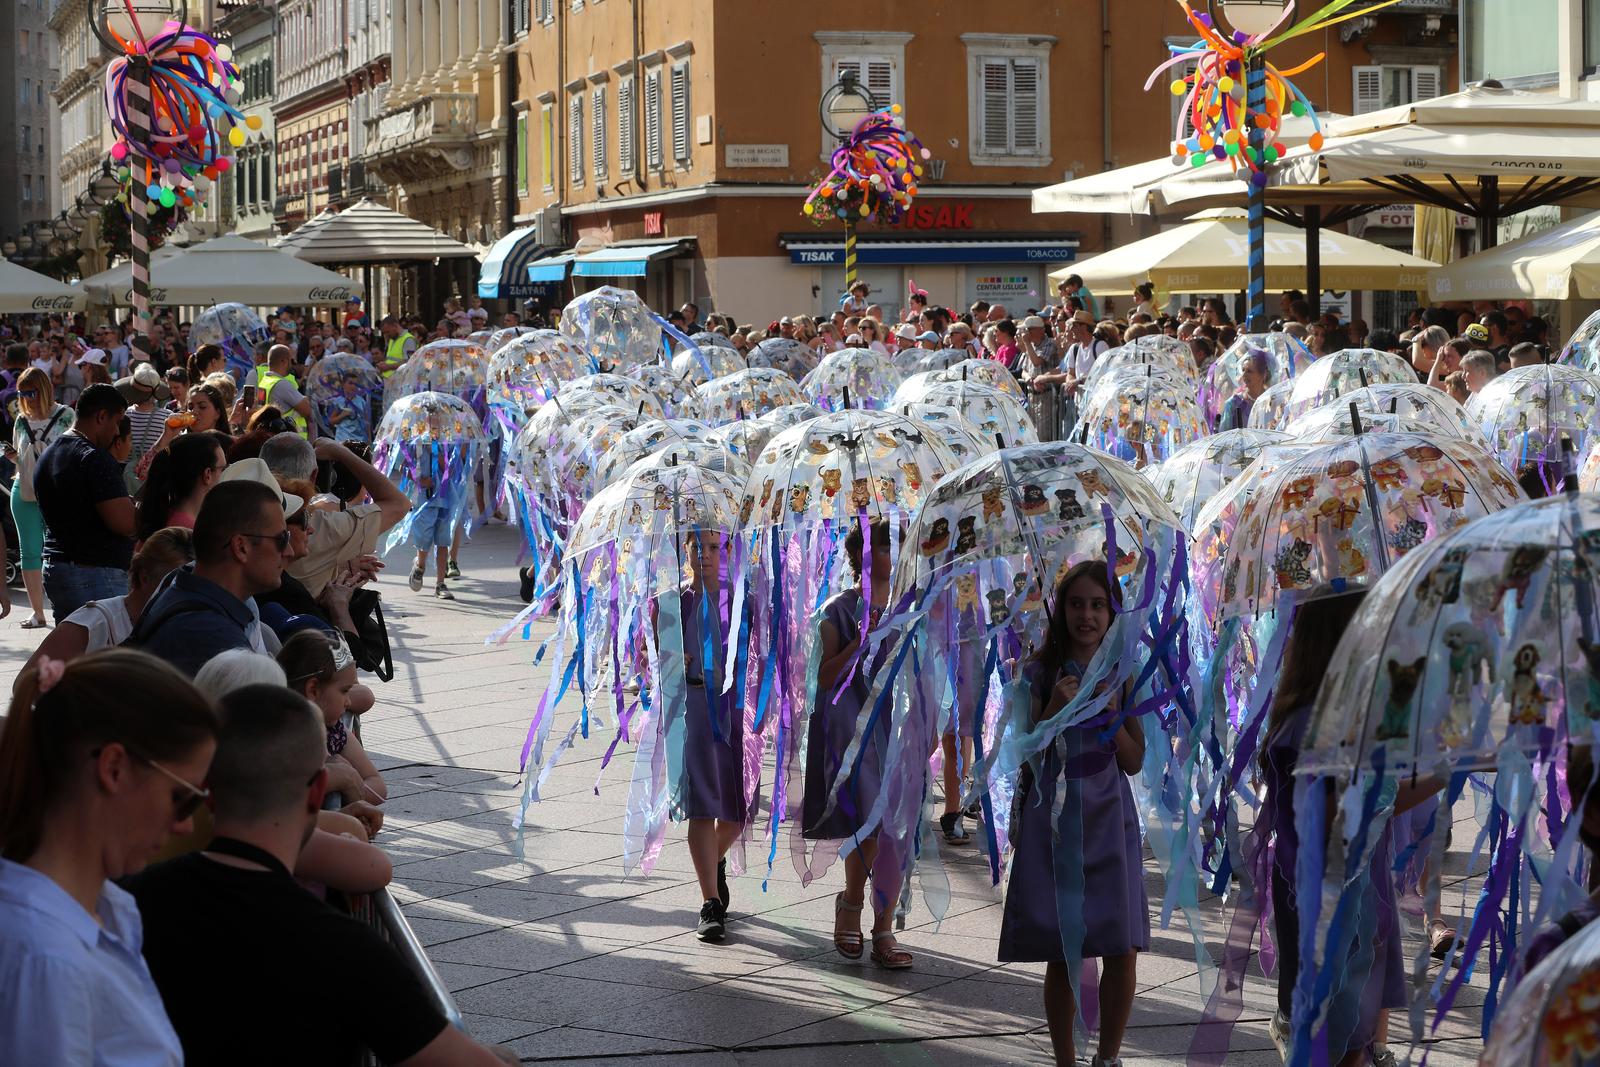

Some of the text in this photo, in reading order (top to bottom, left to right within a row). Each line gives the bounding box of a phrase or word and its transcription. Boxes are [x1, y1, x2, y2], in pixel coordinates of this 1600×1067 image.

[644, 212, 661, 234] TISAK
[800, 251, 835, 261] TISAK
[1026, 249, 1068, 258] TOBACCO
[510, 286, 546, 296] ZLATAR
